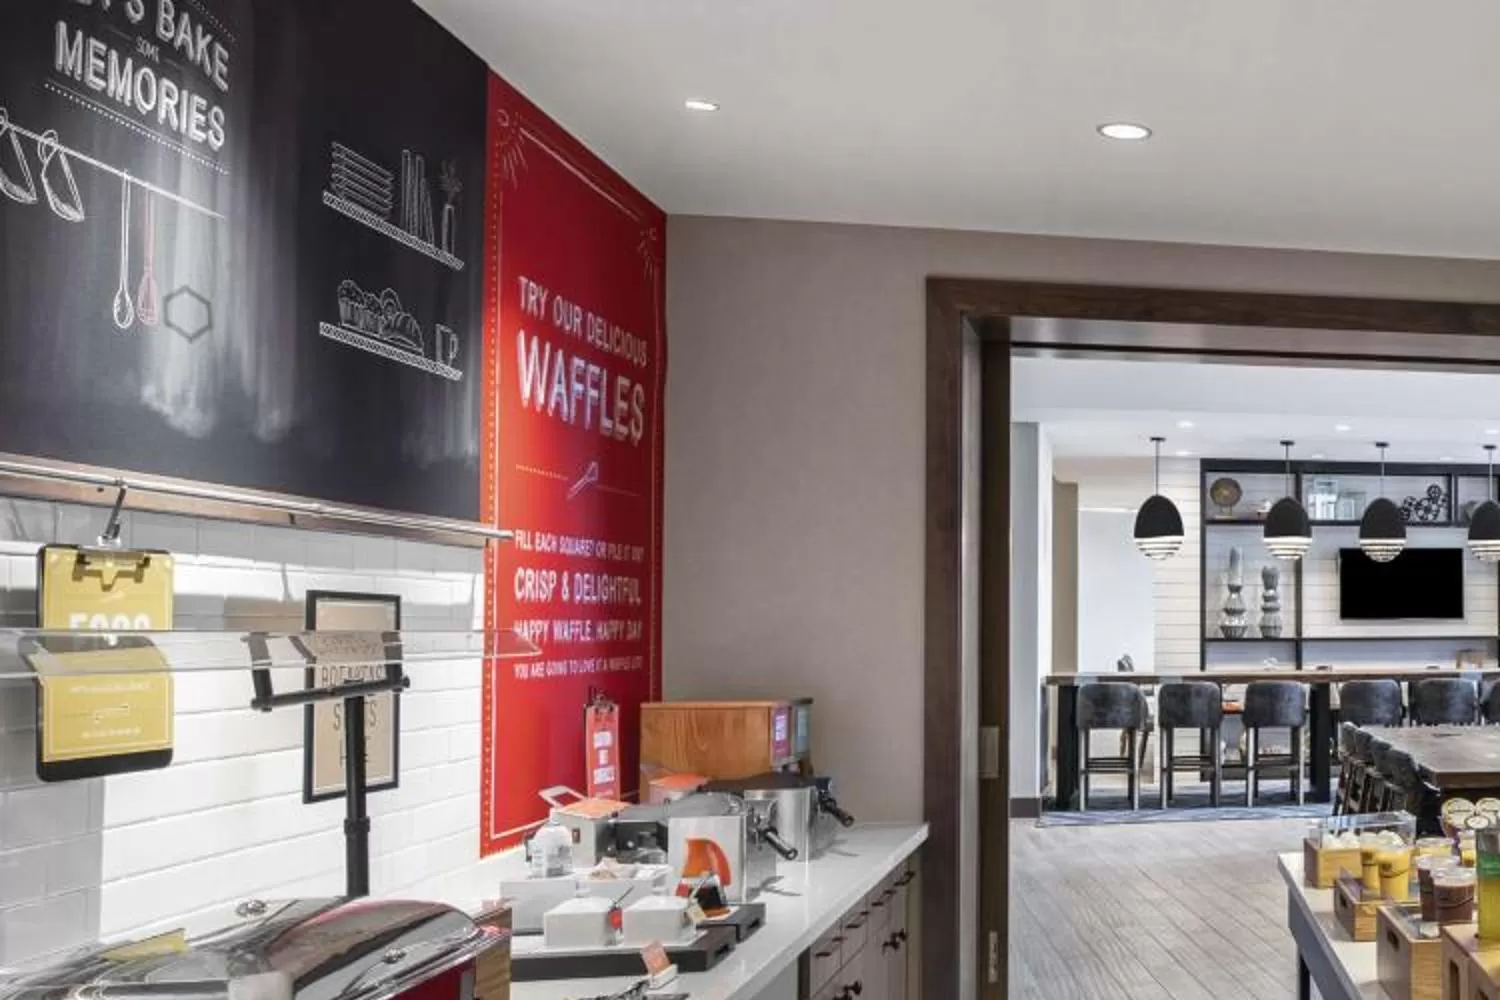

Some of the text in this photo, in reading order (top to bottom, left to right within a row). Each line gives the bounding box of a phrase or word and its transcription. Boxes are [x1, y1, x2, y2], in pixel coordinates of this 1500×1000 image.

[55, 20, 226, 151] MEMORIES
[155, 0, 230, 92] BAKE
[517, 275, 648, 367] TRY OUR DELICIOUS
[516, 328, 646, 447] WAFFLES
[515, 528, 533, 550] FILL
[535, 530, 557, 552] EACH
[514, 566, 641, 607] CRISP & DELIGHTFUL
[514, 618, 549, 643] HAPPY
